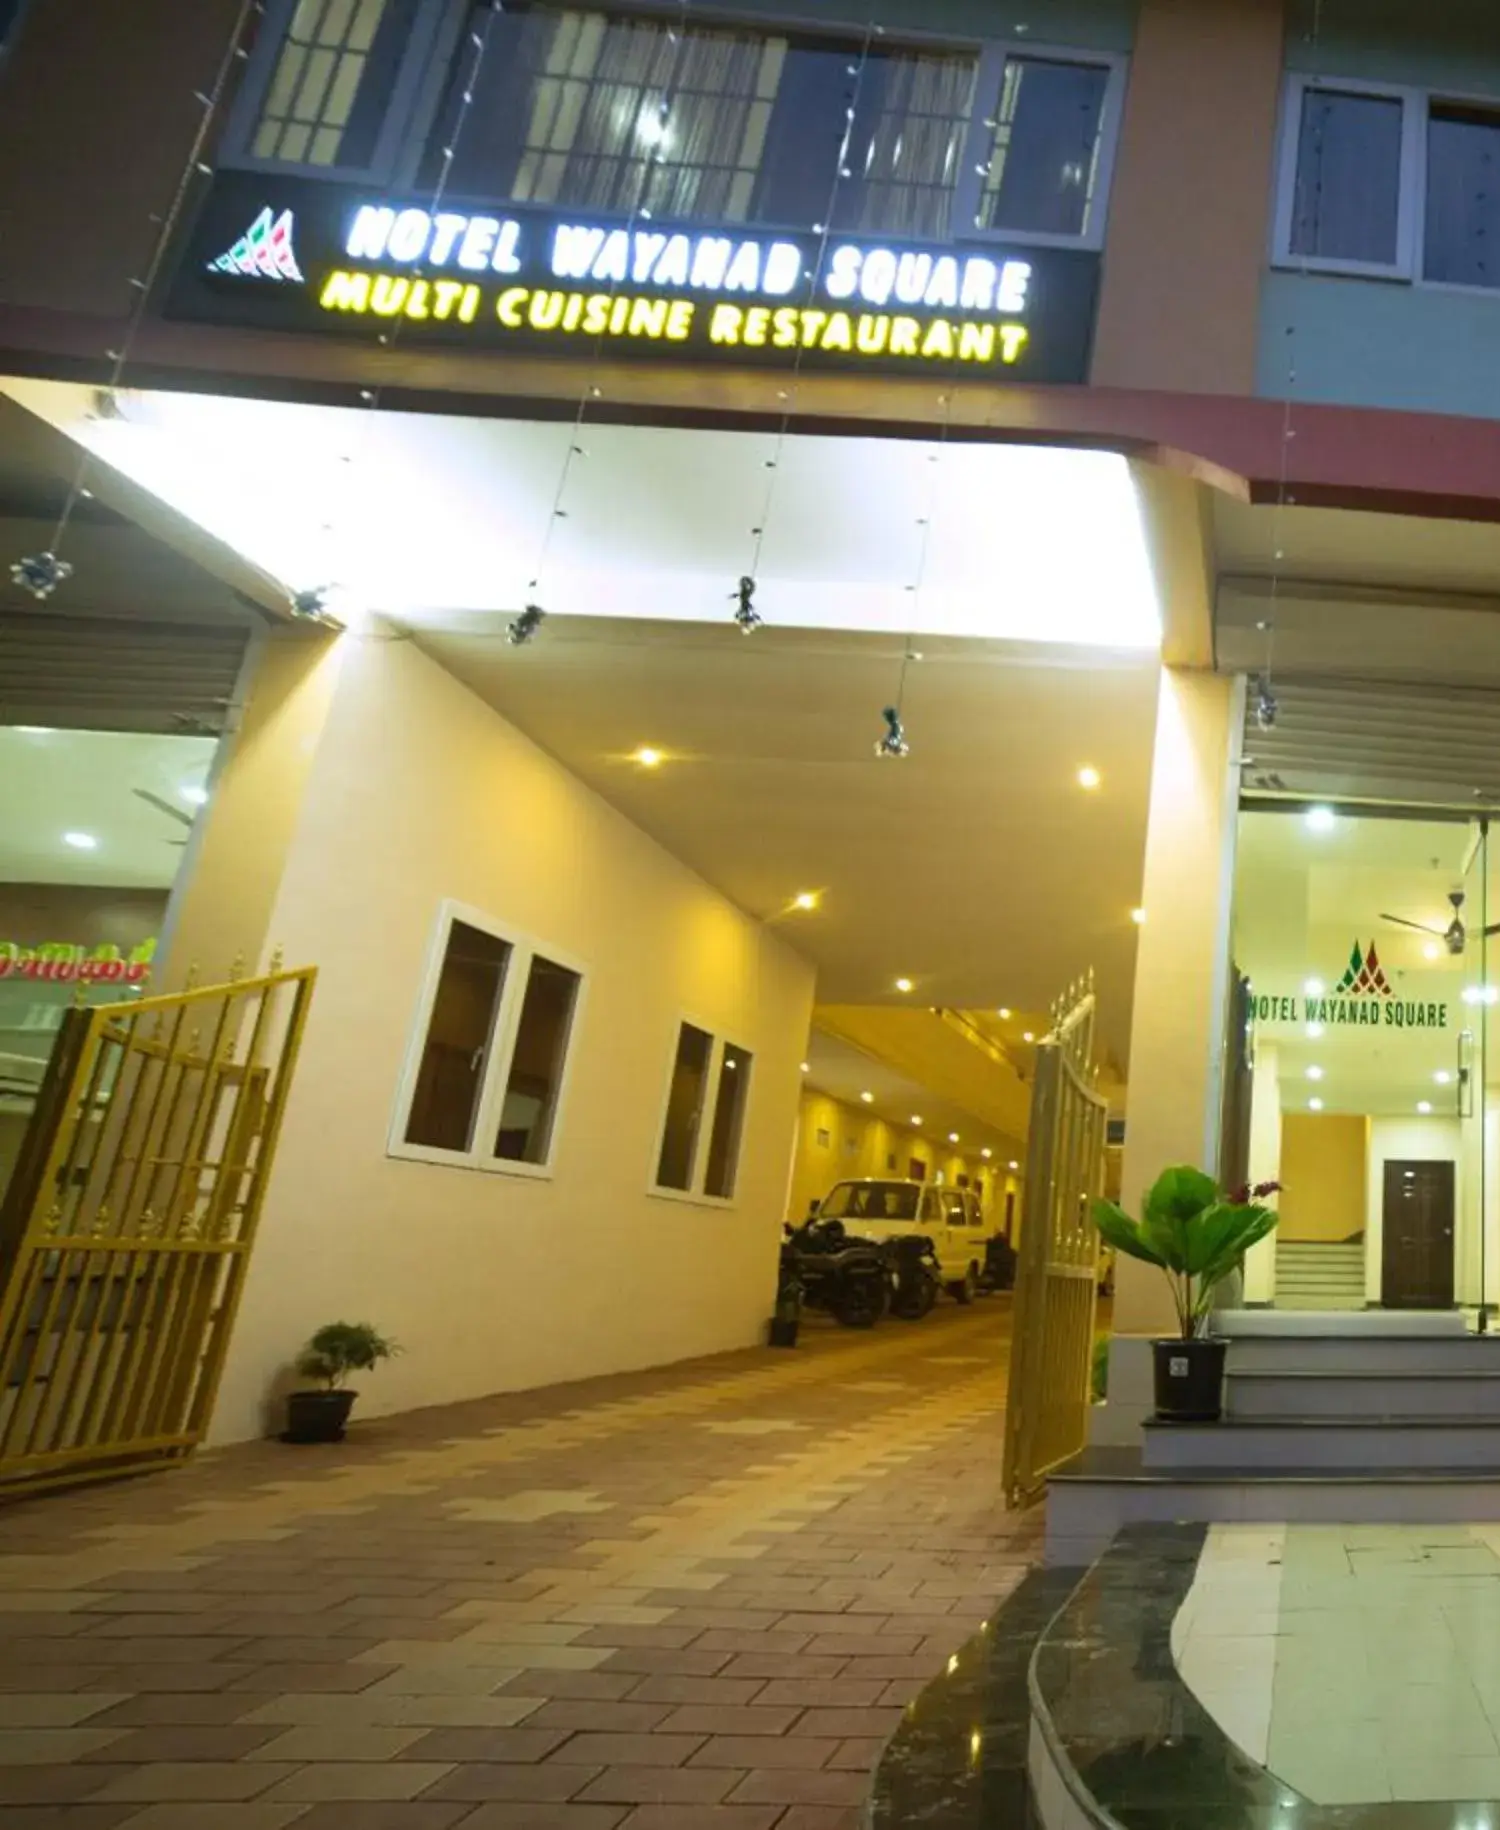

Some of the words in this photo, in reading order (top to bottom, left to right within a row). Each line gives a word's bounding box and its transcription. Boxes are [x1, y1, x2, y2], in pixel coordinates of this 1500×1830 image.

[347, 206, 521, 273] HOTEL
[551, 224, 801, 295] WAYANAD
[826, 246, 1032, 312] SQUARE
[319, 271, 481, 324] MULTI
[496, 287, 694, 341] CUISINE
[709, 304, 1028, 363] RESTAURANT
[1247, 996, 1297, 1022] HOTEL
[1305, 998, 1379, 1025] WAYANAD
[1385, 1001, 1447, 1028] SQUARE
